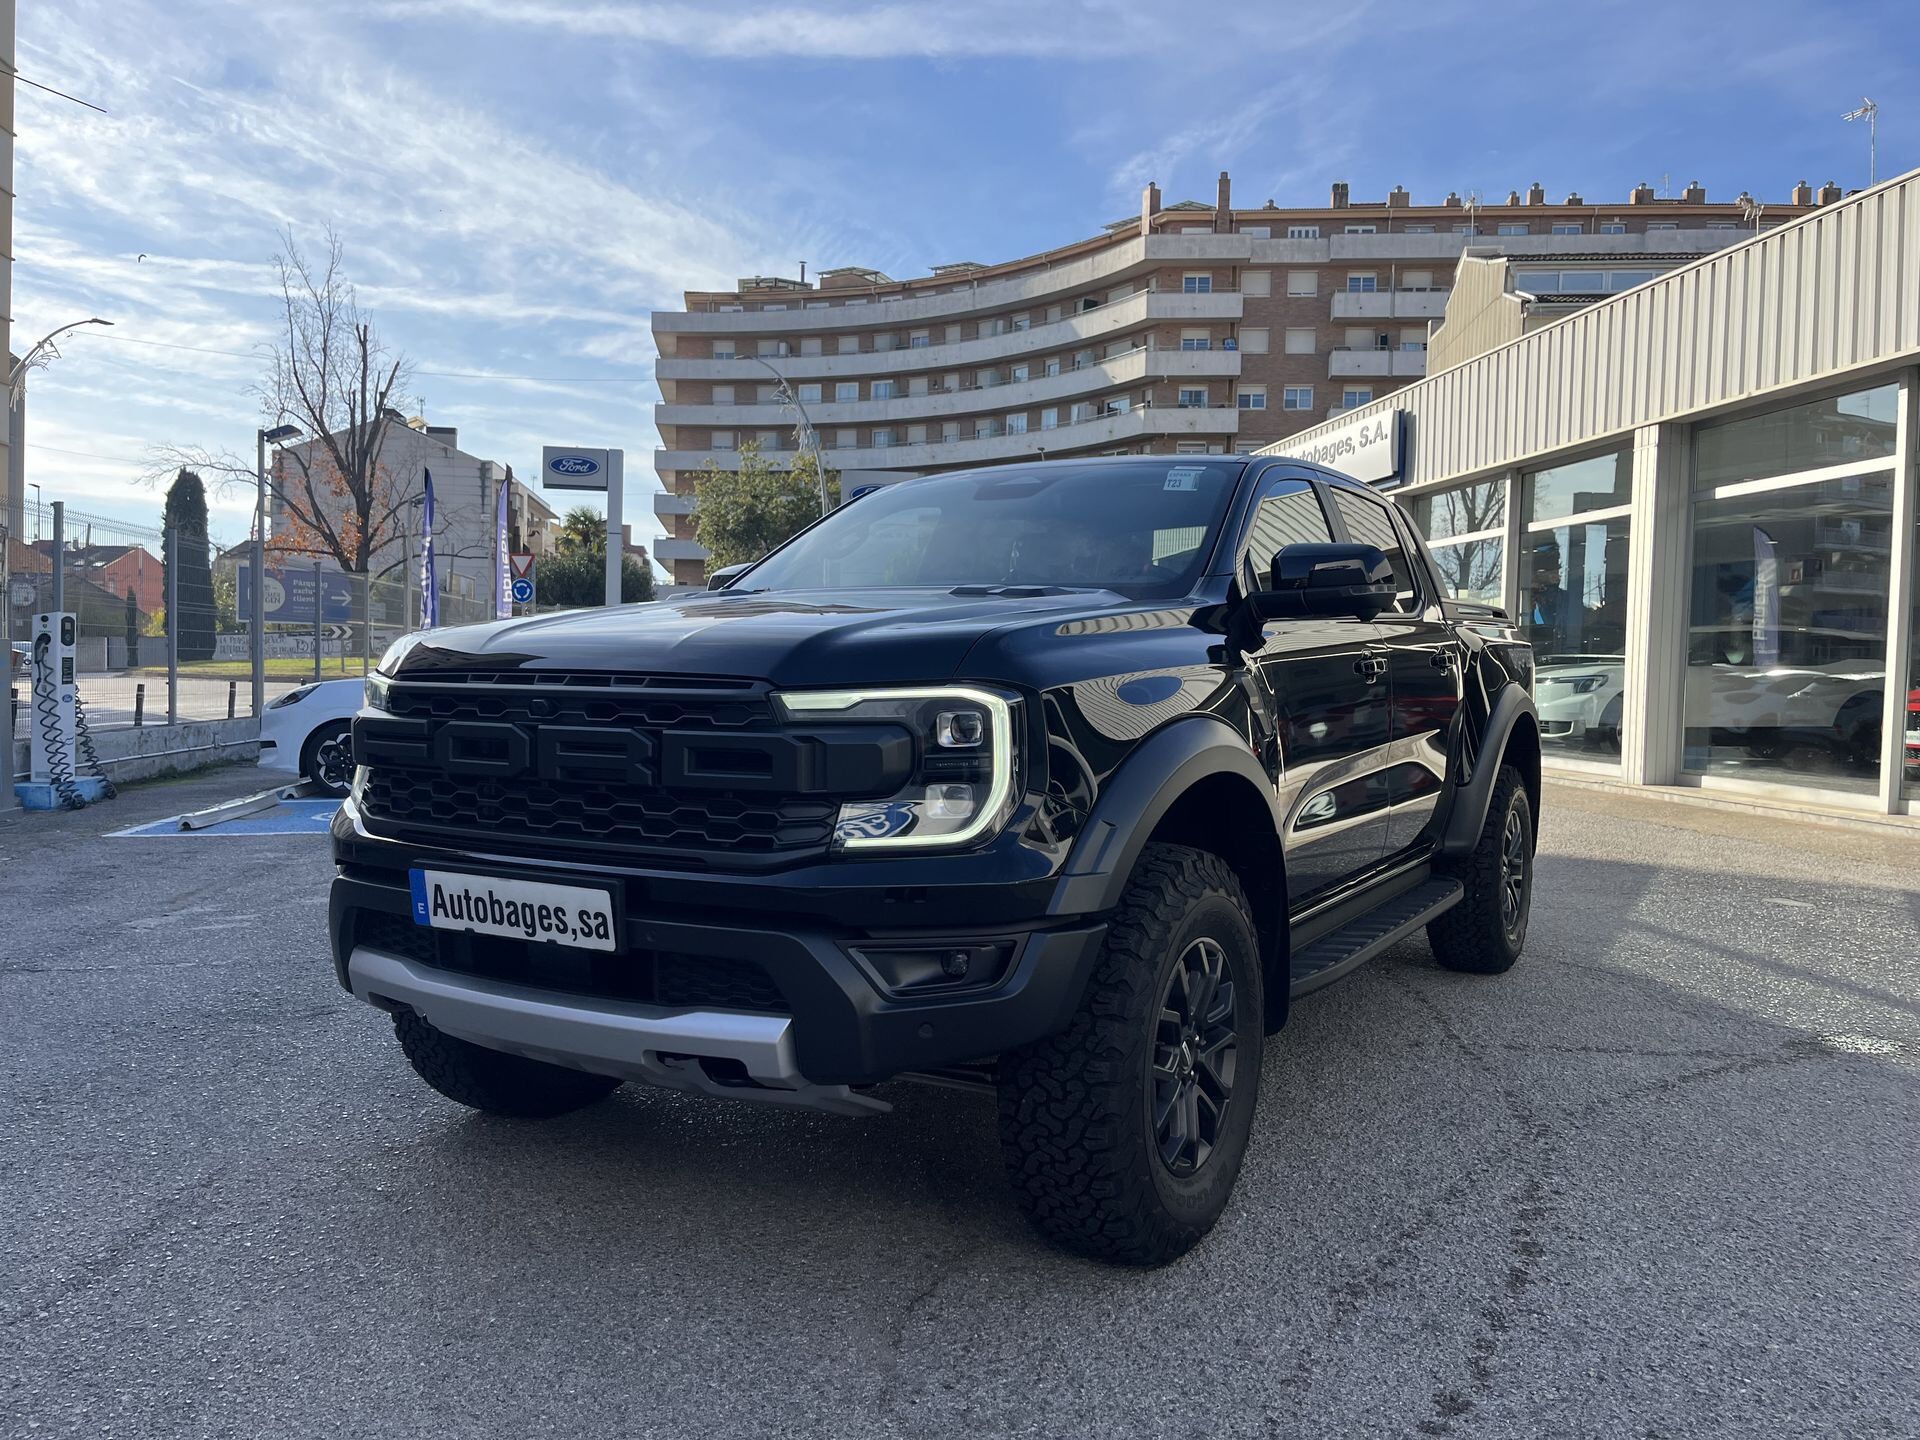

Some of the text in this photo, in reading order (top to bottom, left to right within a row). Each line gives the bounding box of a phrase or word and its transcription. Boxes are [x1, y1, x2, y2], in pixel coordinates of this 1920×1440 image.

[1290, 420, 1388, 464] tobages, S.A.
[560, 459, 590, 472] Ford
[352, 714, 804, 793] FORD
[417, 902, 426, 914] E
[432, 883, 610, 942] Autobages,sa
